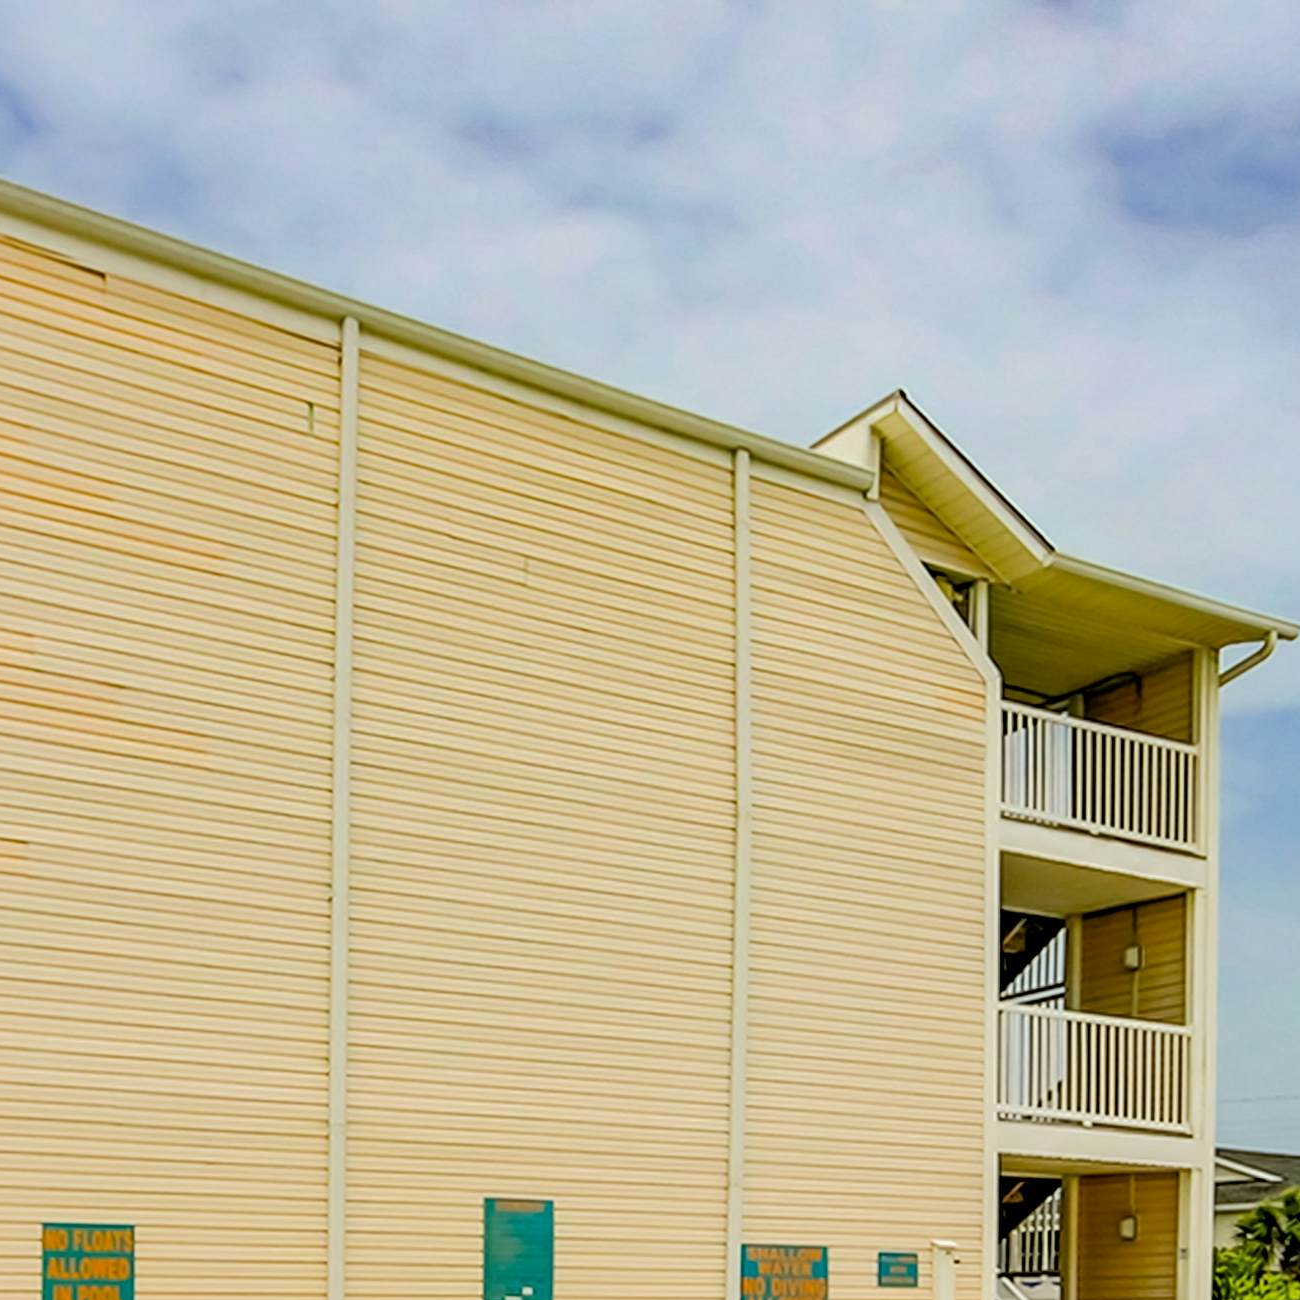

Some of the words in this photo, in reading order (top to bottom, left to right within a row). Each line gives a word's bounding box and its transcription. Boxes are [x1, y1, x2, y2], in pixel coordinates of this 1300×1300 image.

[43, 1229, 67, 1251] NO
[73, 1229, 133, 1253] FLOATS
[47, 1257, 130, 1281] ALLOWED
[759, 1260, 812, 1275] WATER
[742, 1278, 765, 1296] NO
[772, 1279, 826, 1297] DIVING
